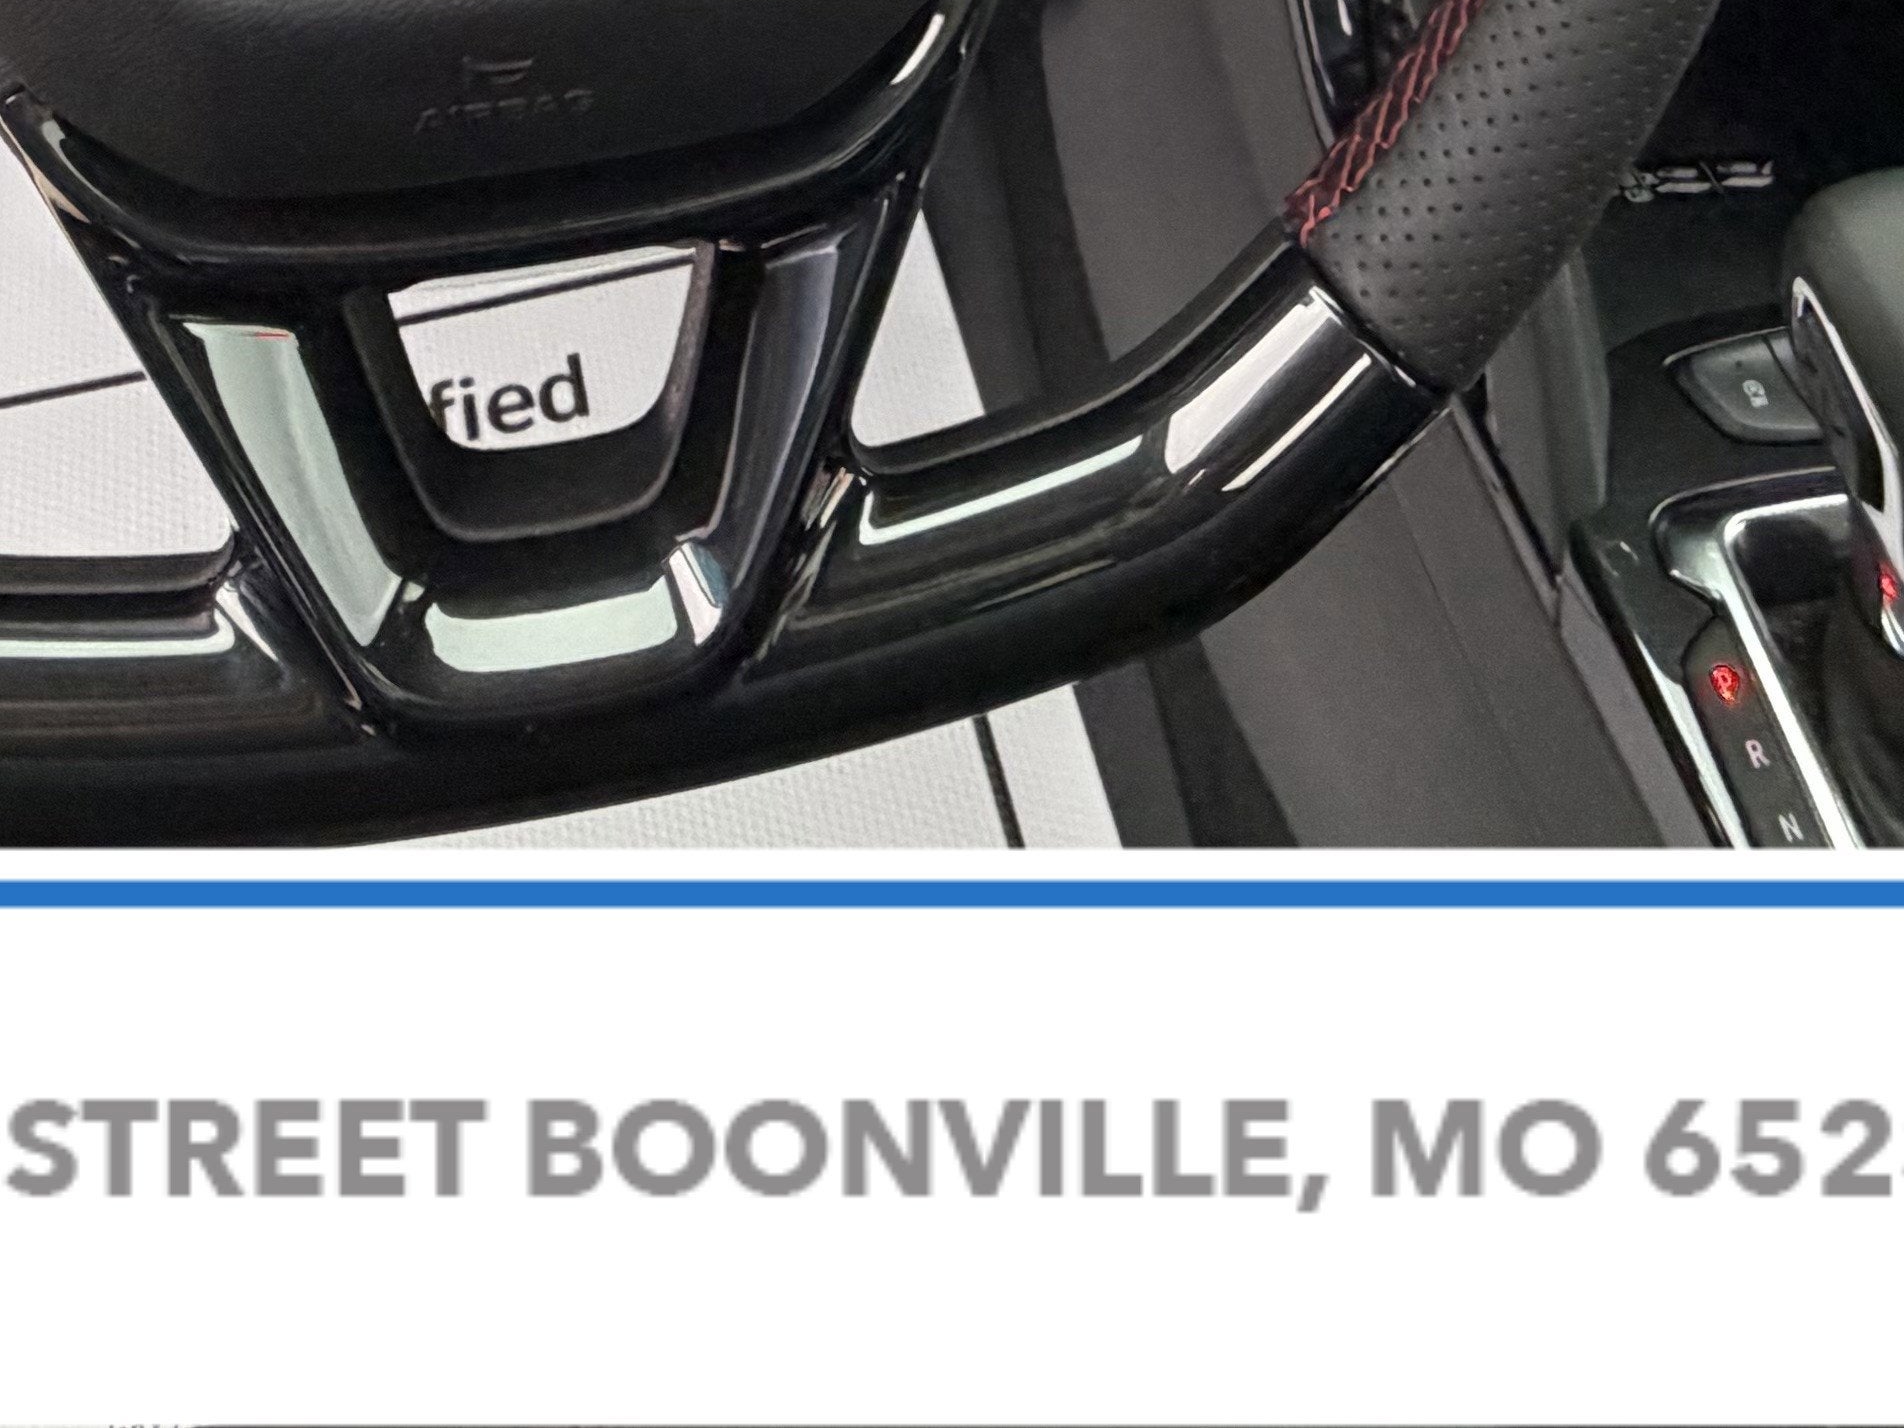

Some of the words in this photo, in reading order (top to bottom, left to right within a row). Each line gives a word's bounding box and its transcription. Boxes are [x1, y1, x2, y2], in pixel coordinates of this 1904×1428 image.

[1710, 665, 1739, 701] P
[1745, 739, 1770, 769] R
[1778, 812, 1804, 843] N
